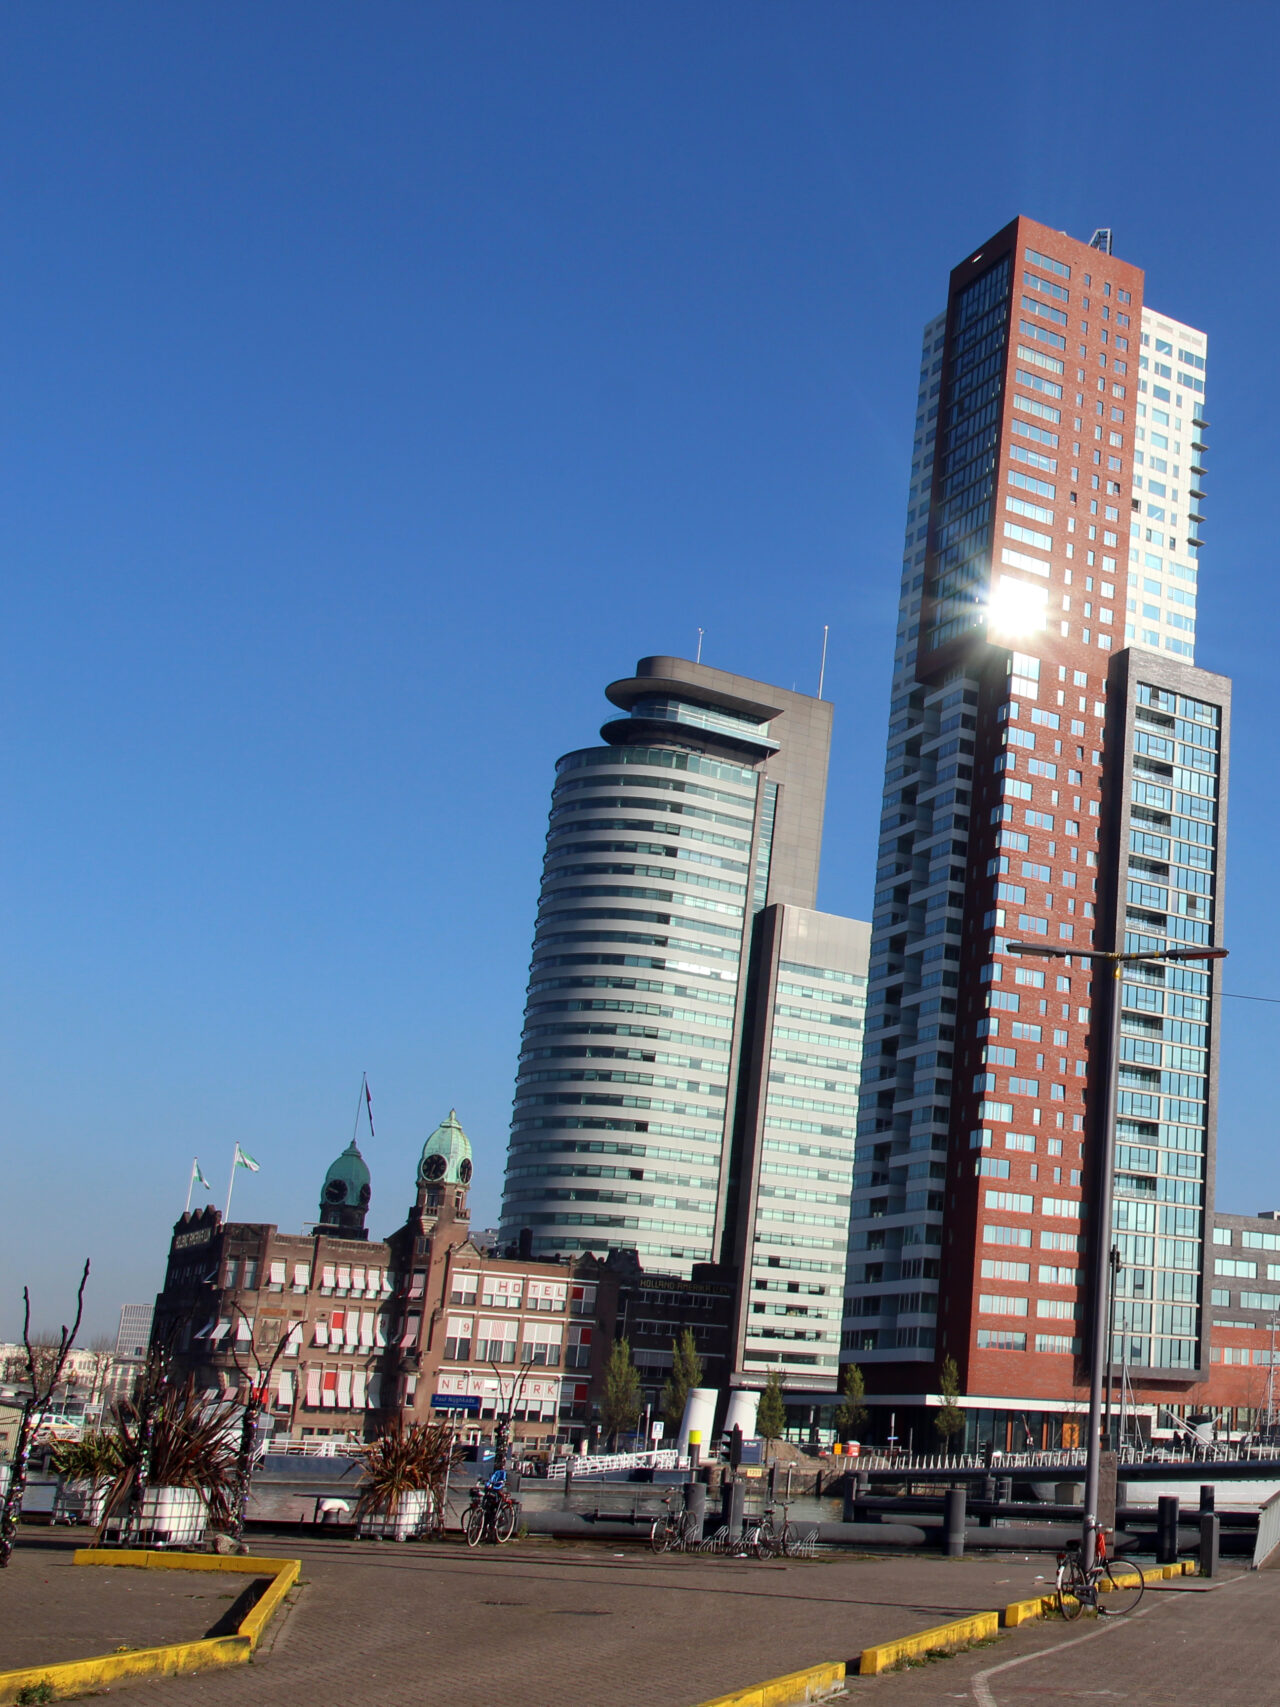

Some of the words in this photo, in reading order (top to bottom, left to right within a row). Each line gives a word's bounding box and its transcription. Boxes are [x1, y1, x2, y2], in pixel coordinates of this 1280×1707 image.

[499, 1281, 563, 1297] HOTEL
[463, 1322, 470, 1332] 9
[441, 1379, 482, 1390] NEW
[503, 1382, 554, 1395] YORK
